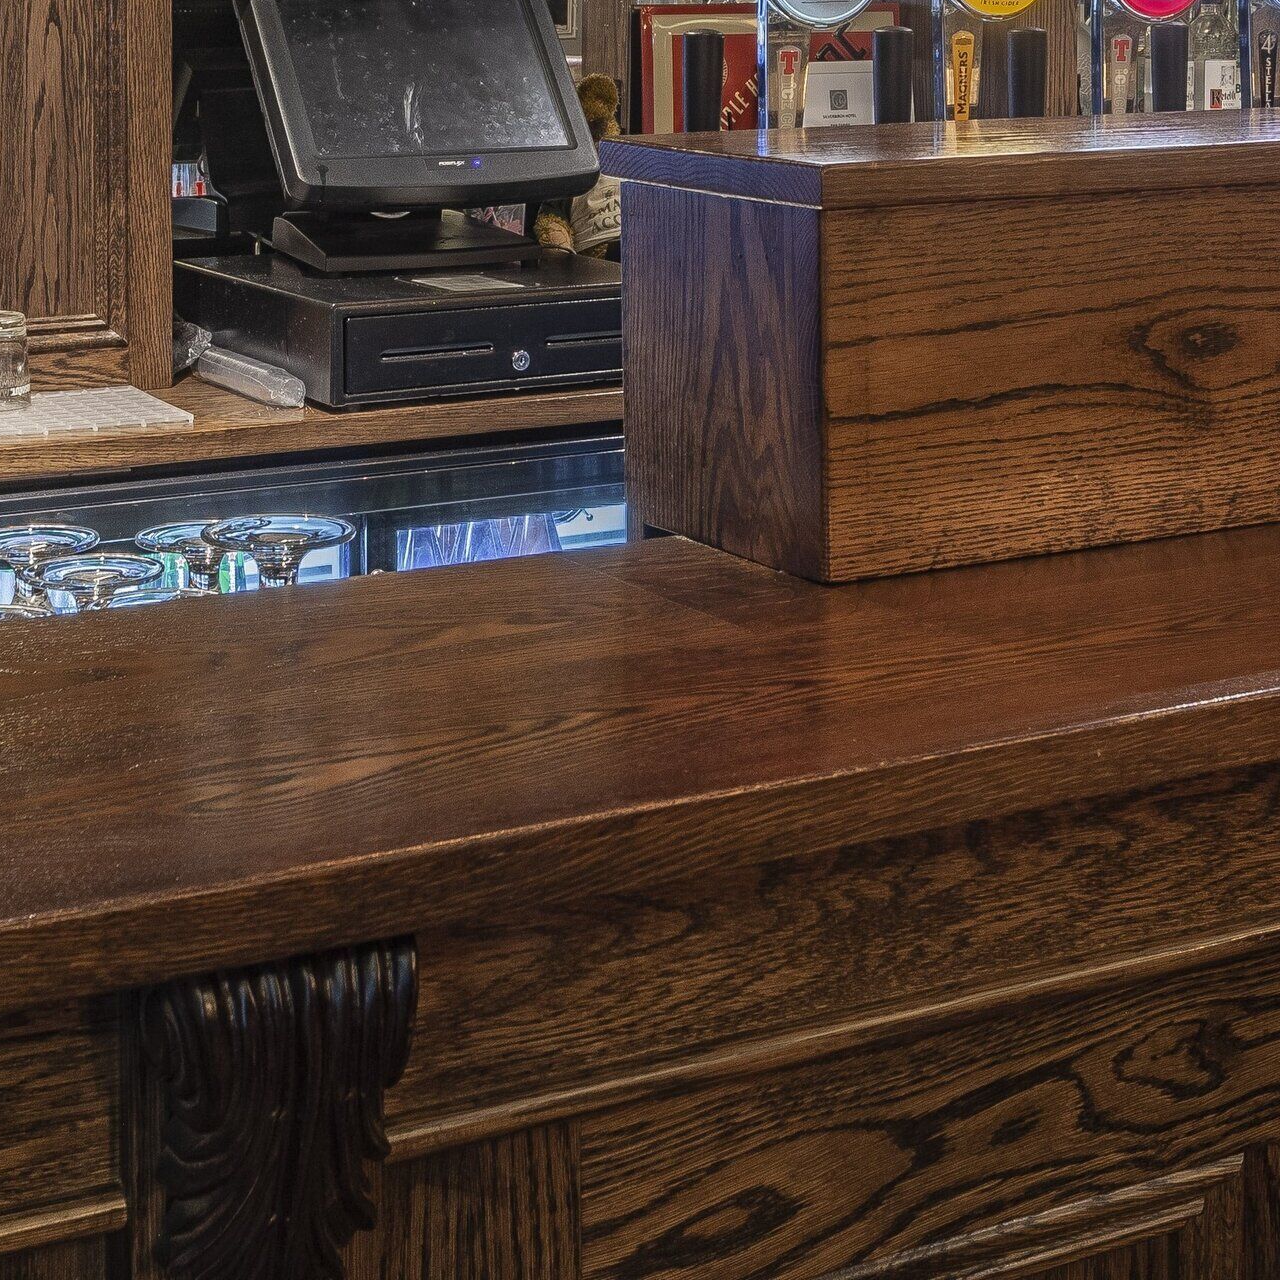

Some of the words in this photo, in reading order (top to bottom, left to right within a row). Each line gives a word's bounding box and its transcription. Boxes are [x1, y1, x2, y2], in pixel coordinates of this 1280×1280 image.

[780, 50, 799, 75] T
[1114, 39, 1130, 61] T
[957, 51, 968, 114] MAGNERS
